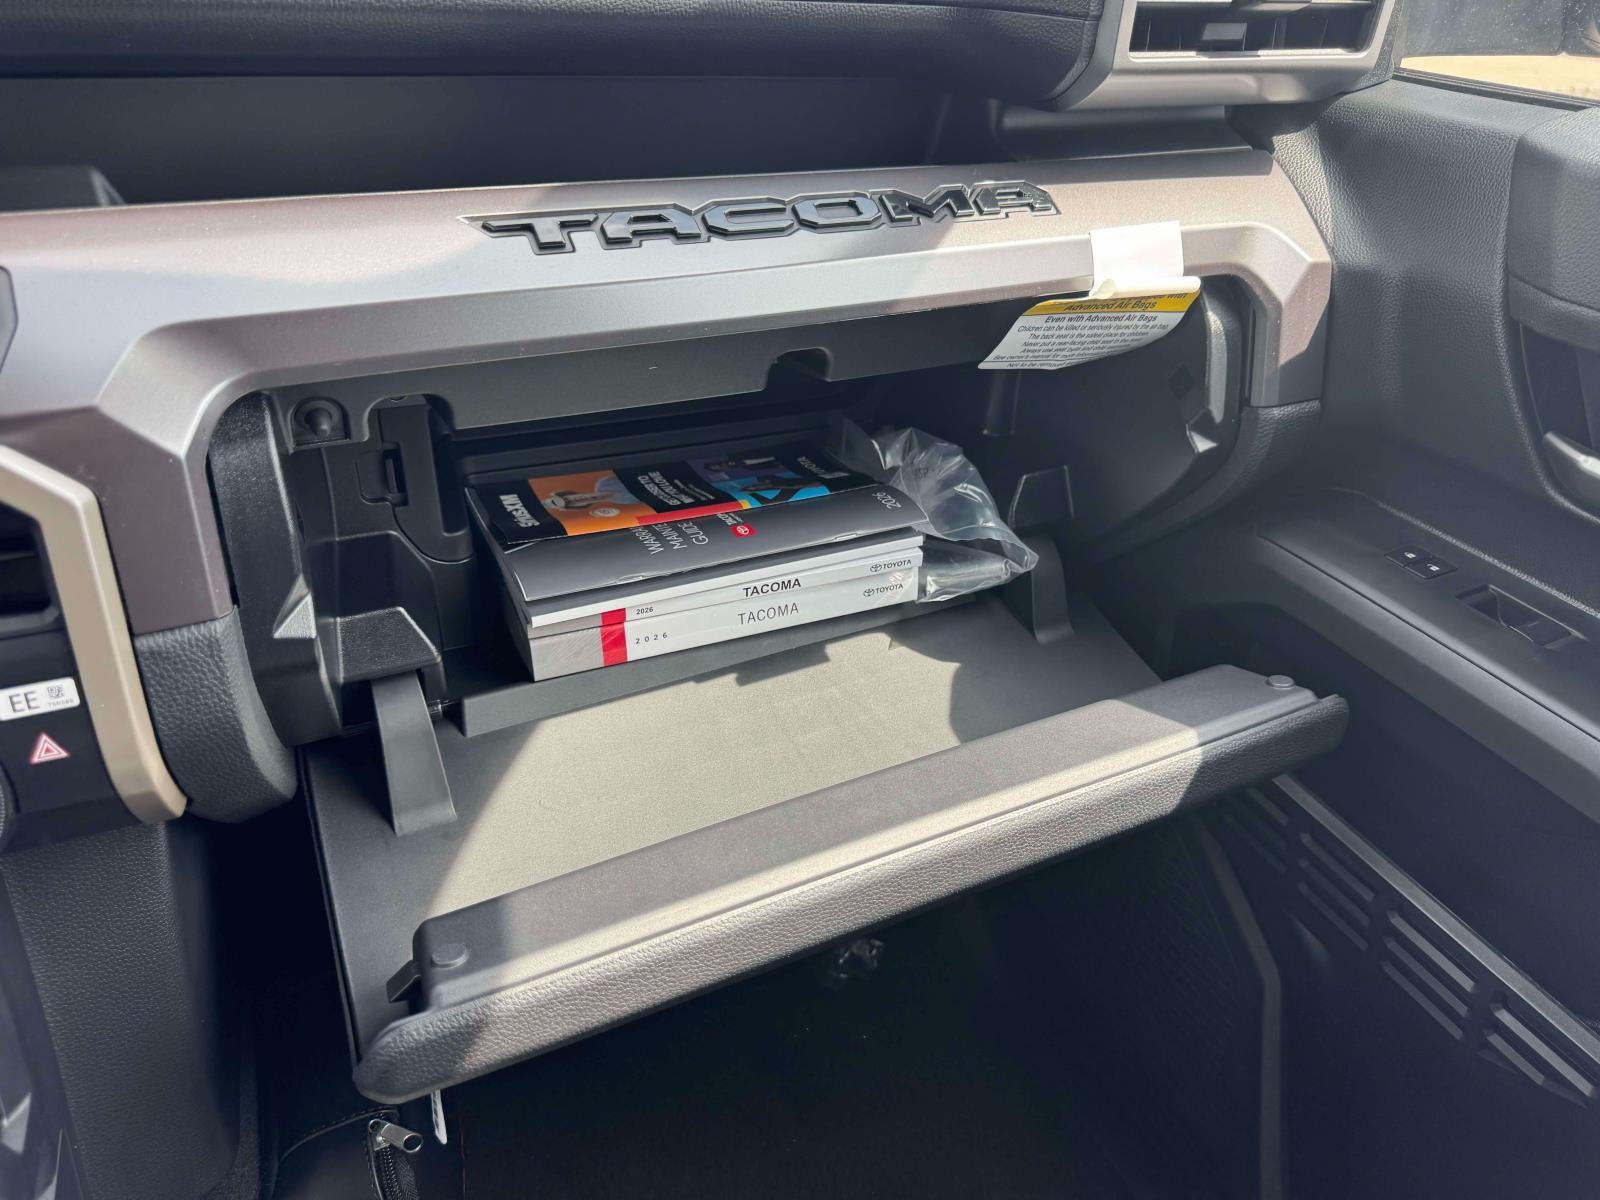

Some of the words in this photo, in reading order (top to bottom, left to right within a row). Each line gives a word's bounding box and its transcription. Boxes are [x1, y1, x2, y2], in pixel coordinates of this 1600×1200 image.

[481, 180, 1057, 254] TACOMA
[1064, 302, 1113, 312] Advanced
[1114, 301, 1130, 309] Air
[1132, 300, 1158, 310] Bags
[1045, 315, 1065, 323] Even
[1085, 314, 1125, 322] Advanced
[1137, 313, 1158, 322] Bags
[872, 491, 902, 509] 2026
[499, 494, 540, 528] SiriusXM
[716, 513, 738, 526] TACO
[630, 525, 665, 555] WARRA
[652, 522, 688, 549] MAINTE
[677, 520, 709, 545] GUIDE
[883, 559, 912, 569] TOYOTA
[742, 578, 802, 598] TACOMA
[876, 583, 904, 593] TOYOTA
[636, 606, 654, 615] 2026
[737, 602, 800, 626] TACOMA
[9, 690, 41, 713] EE
